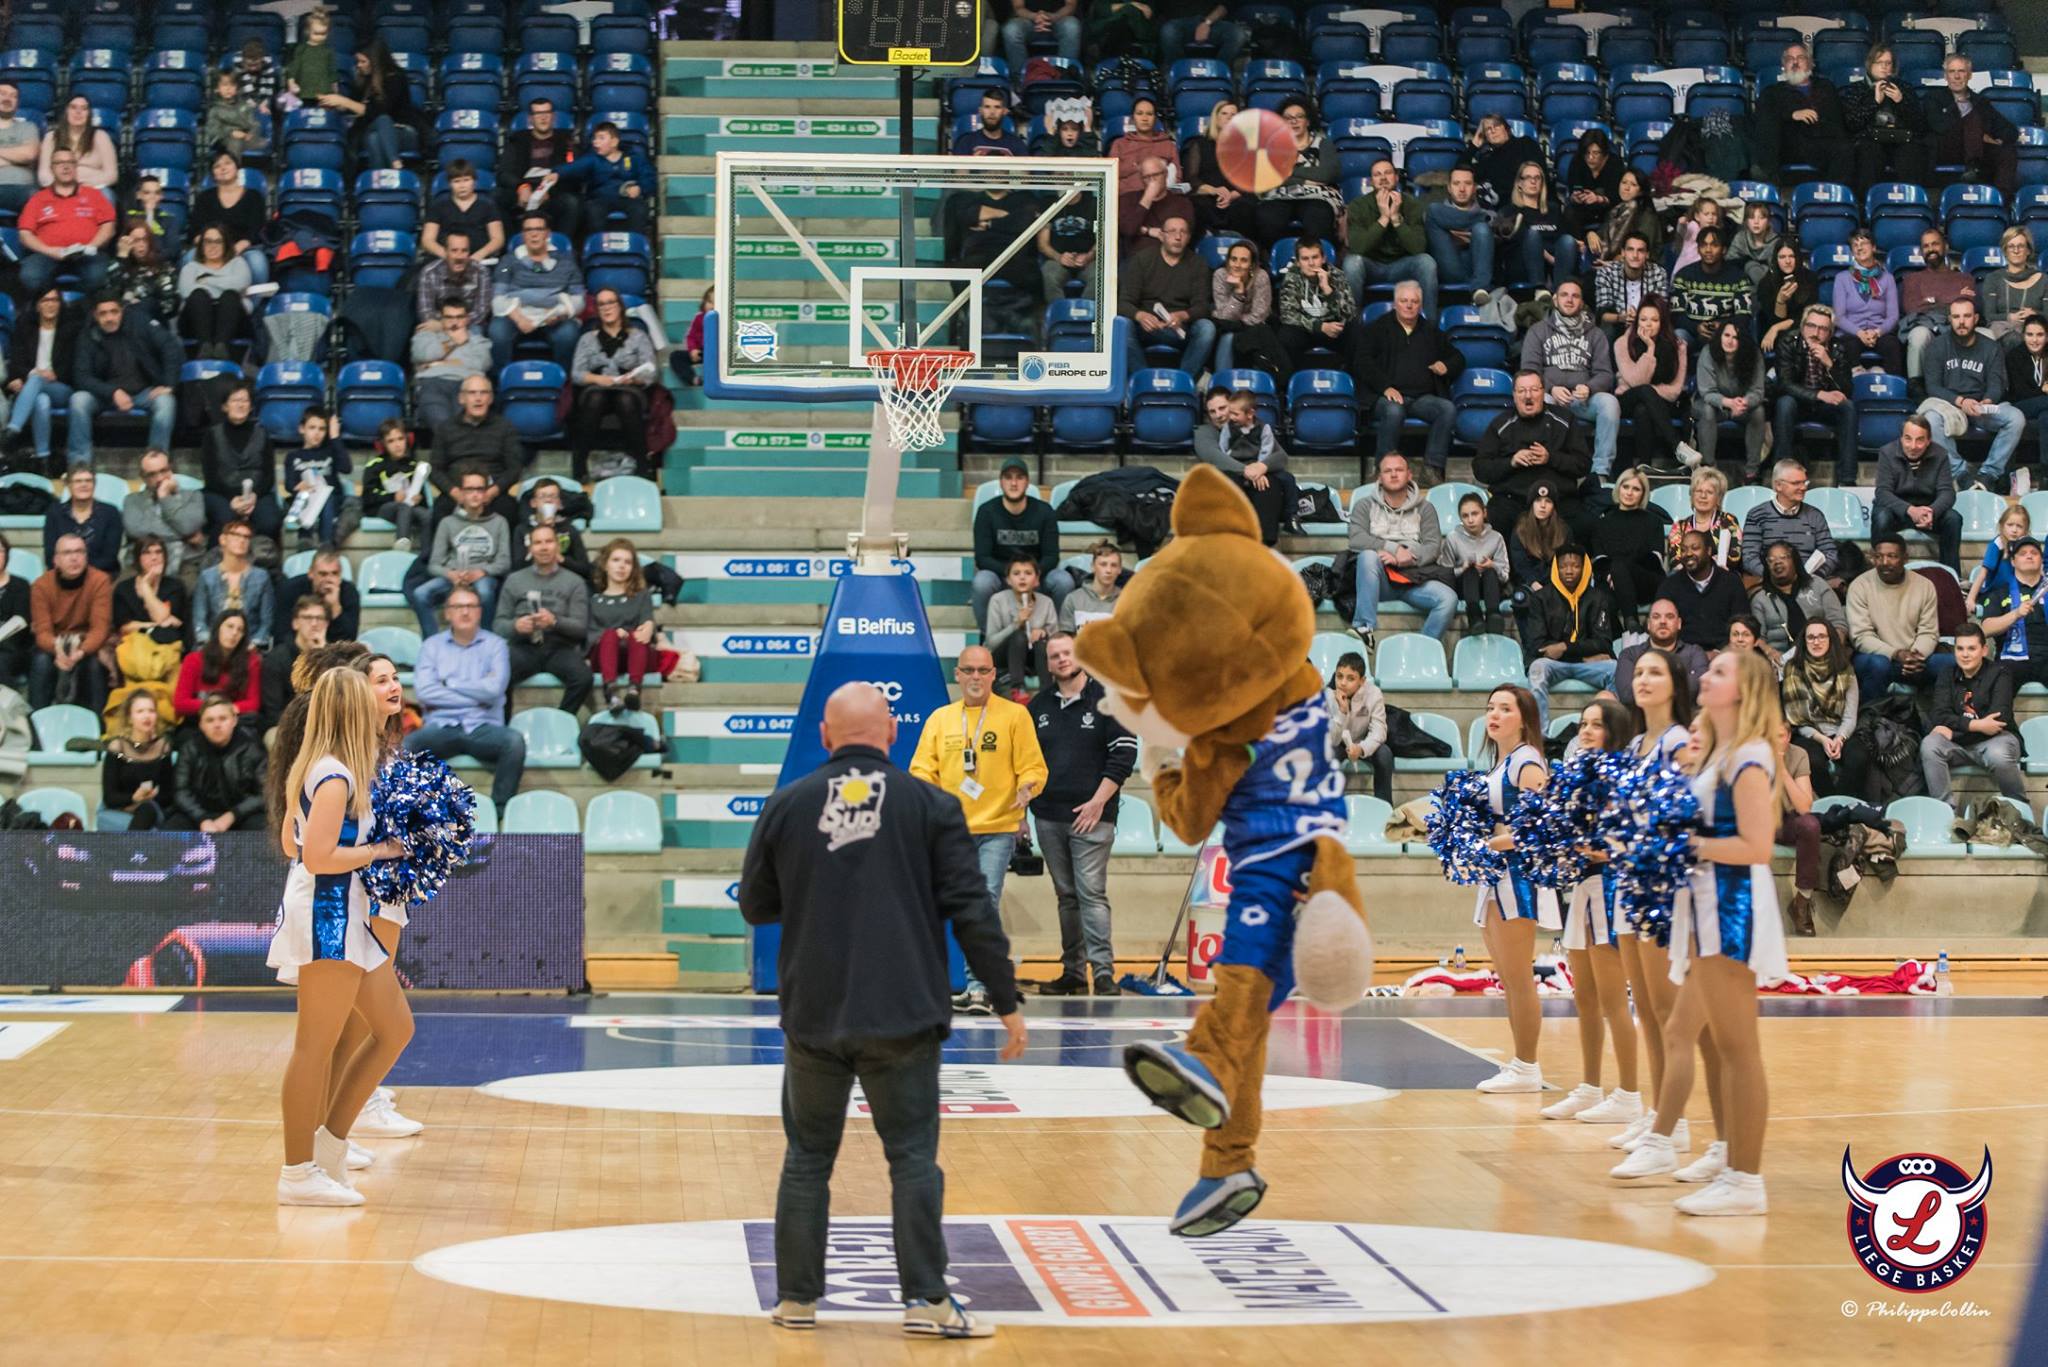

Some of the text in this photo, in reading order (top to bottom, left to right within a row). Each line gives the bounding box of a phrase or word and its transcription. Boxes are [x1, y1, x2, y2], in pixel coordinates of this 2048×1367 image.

[893, 50, 928, 60] Bodet
[1962, 360, 1984, 373] GOLD
[795, 562, 808, 575] C
[831, 562, 844, 574] C
[858, 618, 915, 635] Belfius
[795, 638, 808, 651] C
[729, 718, 754, 729] 031
[757, 718, 767, 729] à
[896, 713, 920, 724] ARS
[732, 801, 757, 812] 015
[1043, 1264, 1132, 1310] GROUPE
